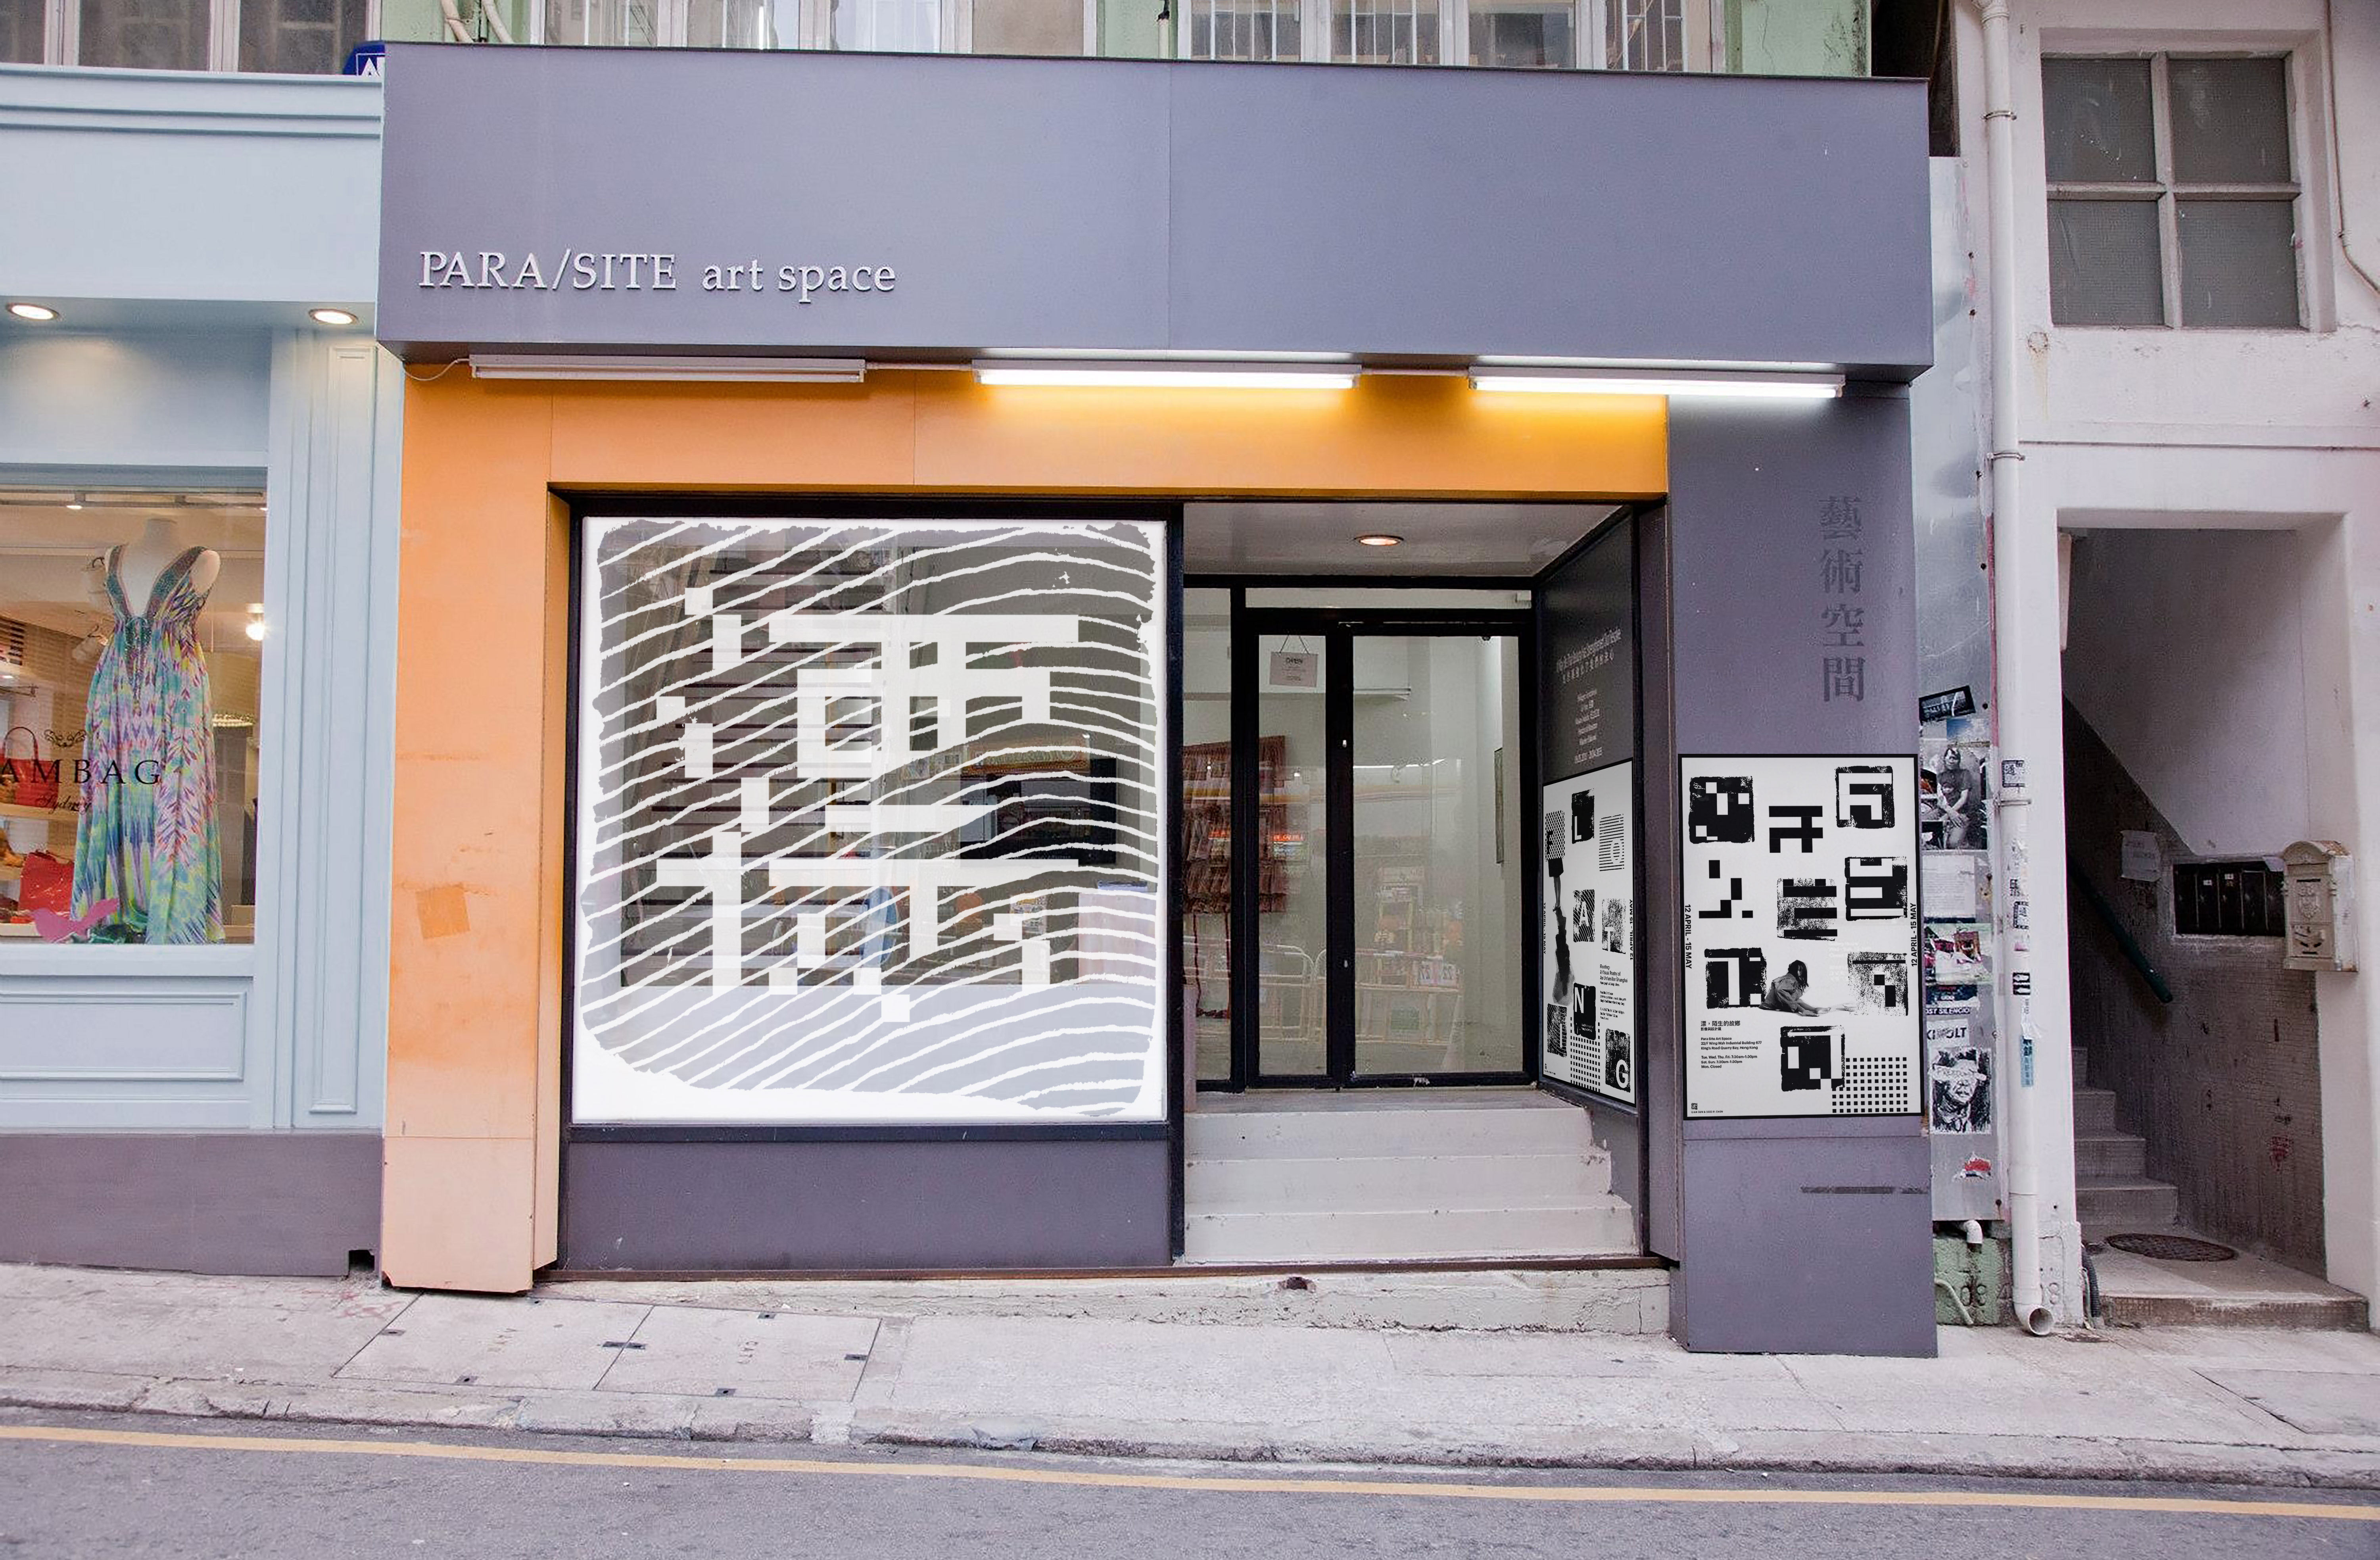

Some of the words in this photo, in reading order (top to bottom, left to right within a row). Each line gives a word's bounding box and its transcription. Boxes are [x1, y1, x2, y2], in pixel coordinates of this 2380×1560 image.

[419, 248, 676, 290] PARA/SITE
[702, 259, 764, 292] art
[777, 262, 896, 304] space
[1818, 496, 1865, 702] 藝術空間
[36, 795, 91, 815] Sydney
